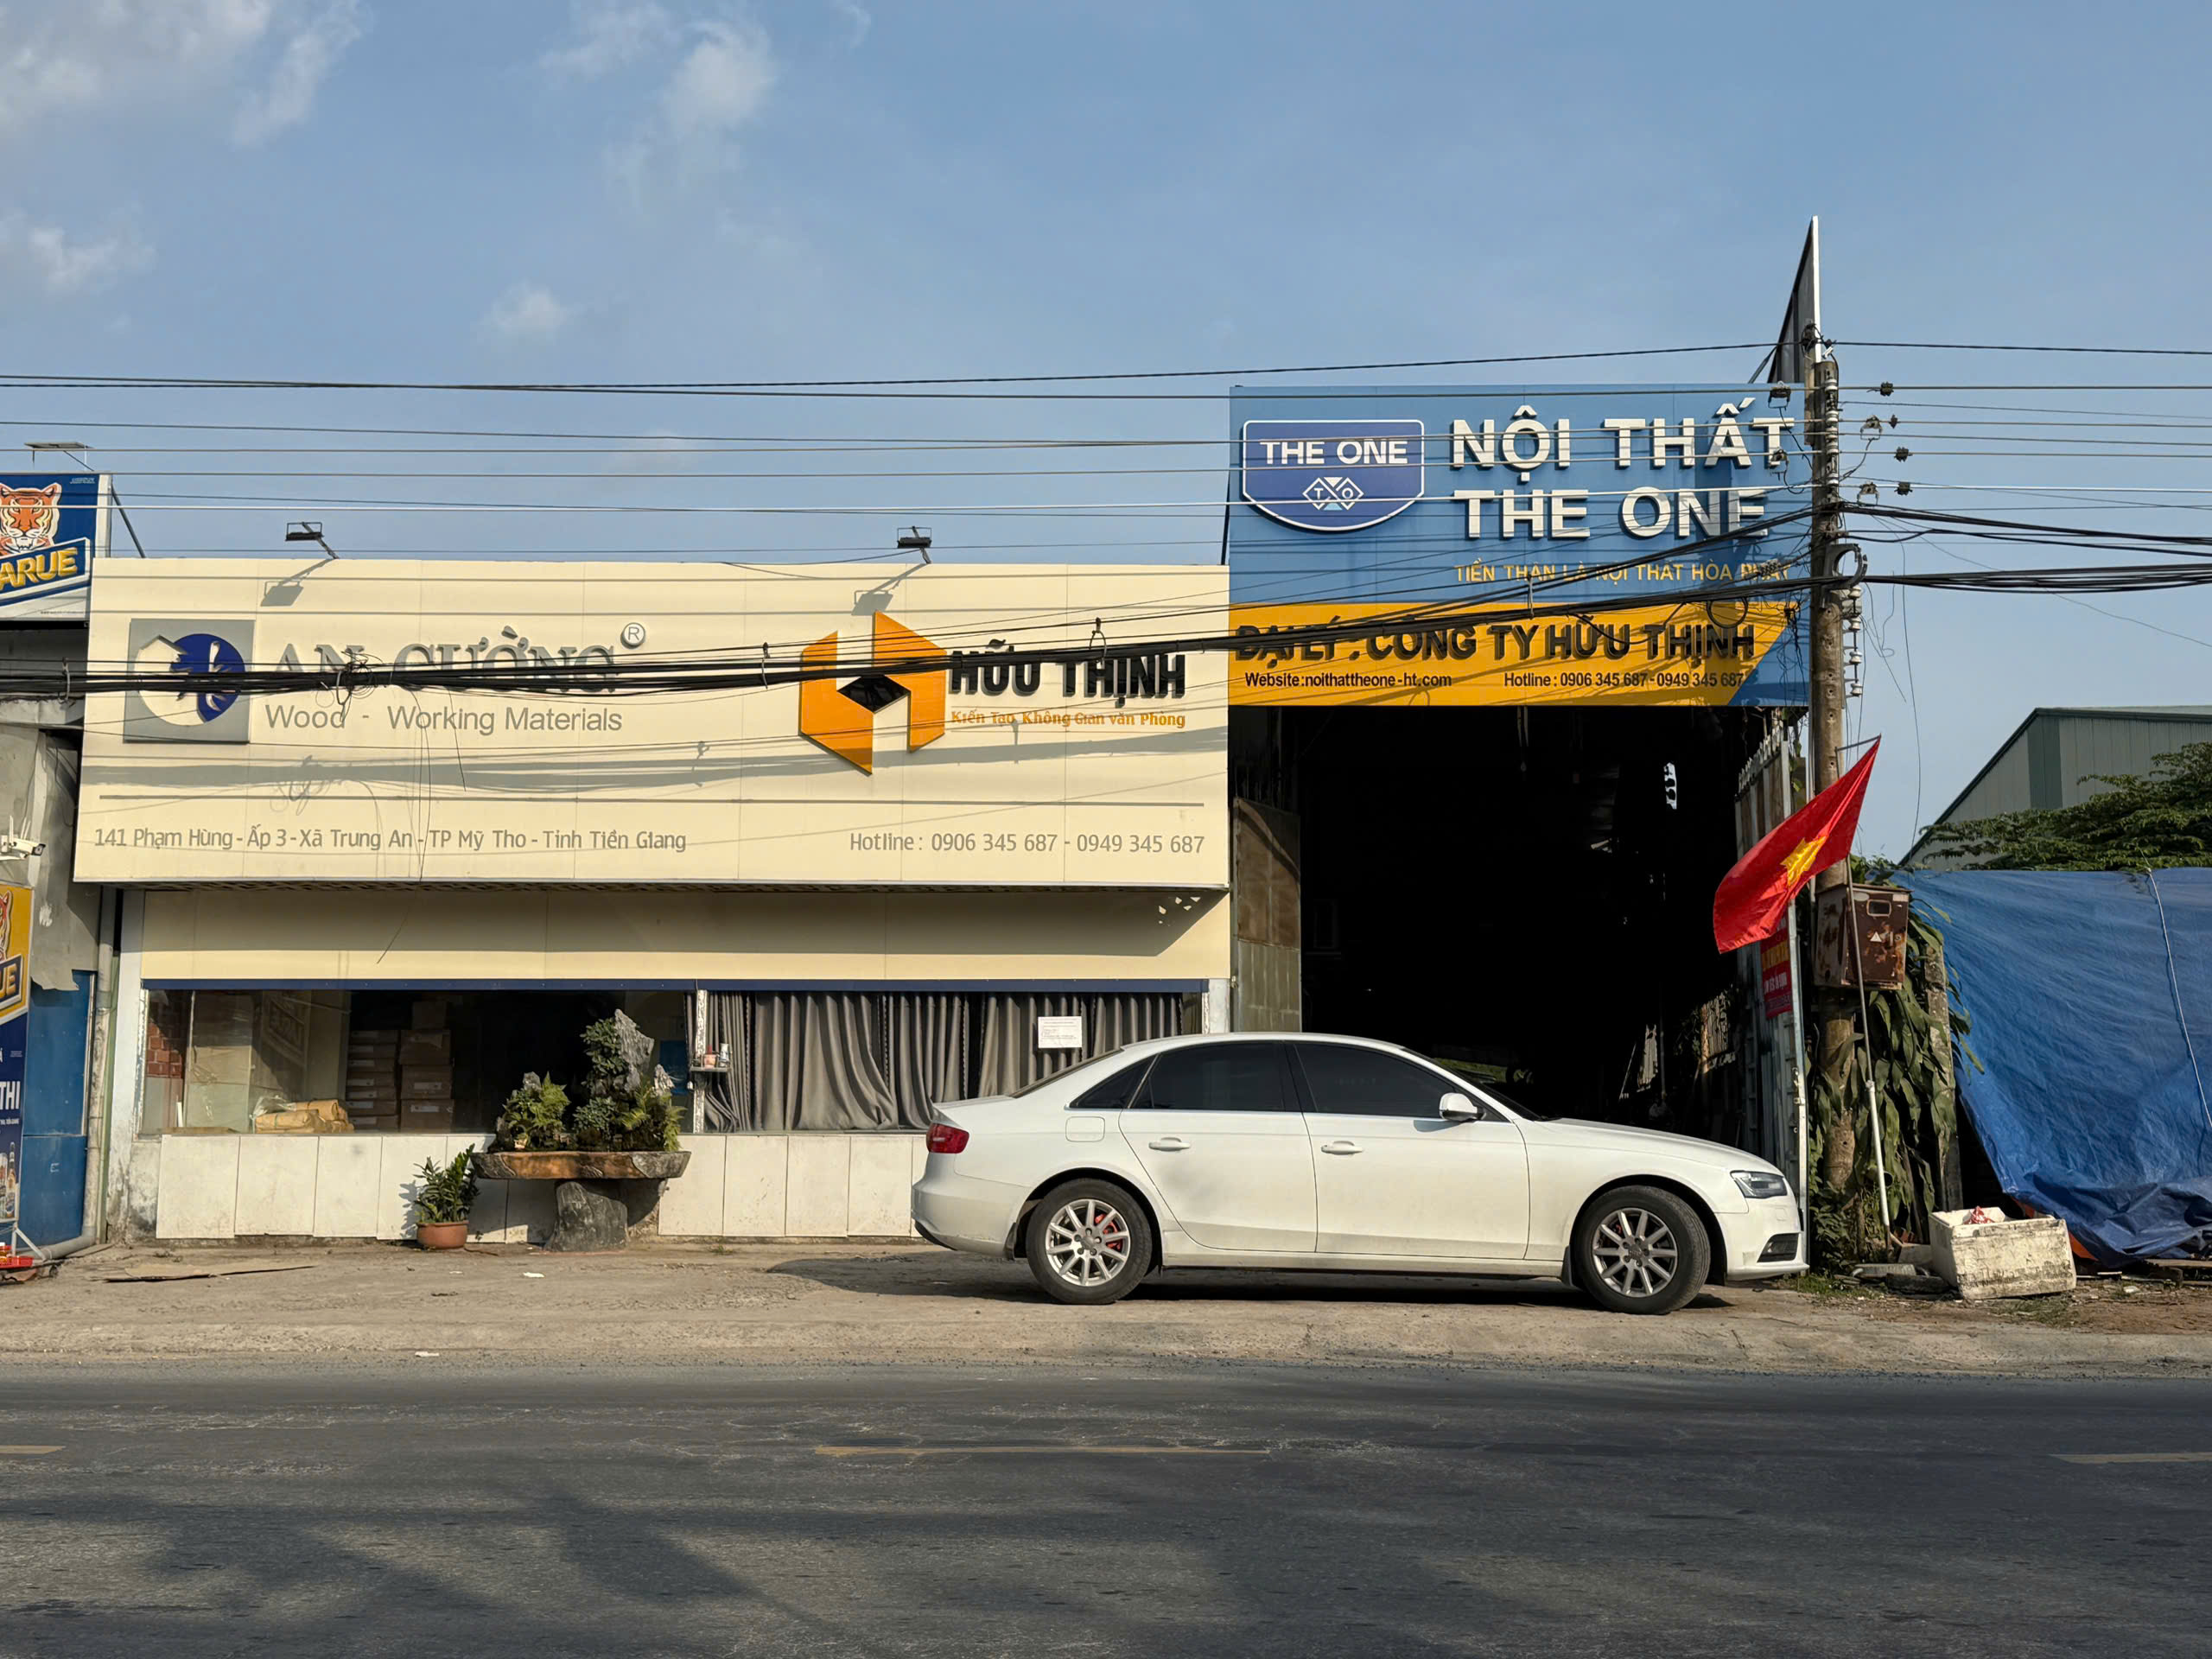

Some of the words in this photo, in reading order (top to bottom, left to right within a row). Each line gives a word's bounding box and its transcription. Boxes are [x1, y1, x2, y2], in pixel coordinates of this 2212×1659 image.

[1259, 439, 1325, 465] THE
[1337, 438, 1408, 465] ONE
[1453, 405, 1571, 482] NỘI
[1603, 397, 1795, 467] THẤT
[1454, 489, 1591, 538] THE
[1621, 486, 1770, 538] ONE
[1691, 559, 1733, 581] HÒA
[1488, 625, 1540, 661] TY
[1544, 615, 1630, 660] HỮU
[1560, 672, 1592, 687] 0906
[1595, 672, 1619, 687] 345
[1692, 672, 1717, 687] 345
[1720, 672, 1744, 687] 687
[265, 704, 345, 728] Wood
[387, 705, 495, 736] Working
[505, 707, 623, 731] Materials
[1022, 710, 1071, 728] Không
[1140, 711, 1185, 728] Phòng
[95, 828, 127, 846] 141
[133, 827, 182, 849] Phạm
[188, 828, 233, 849] Hùng
[246, 824, 271, 850] Ấp
[330, 829, 382, 850] Trung
[388, 830, 413, 848] An
[429, 830, 452, 849] TP
[458, 830, 485, 851] Mỹ
[492, 830, 526, 849] Tho
[588, 829, 629, 849] Tiền
[635, 830, 687, 852] Giang
[931, 833, 976, 852] 0906
[982, 833, 1017, 852] 345
[1023, 834, 1058, 853] 687
[1077, 834, 1123, 853] 0949
[1128, 835, 1163, 854] 345
[1169, 836, 1205, 854] 687
